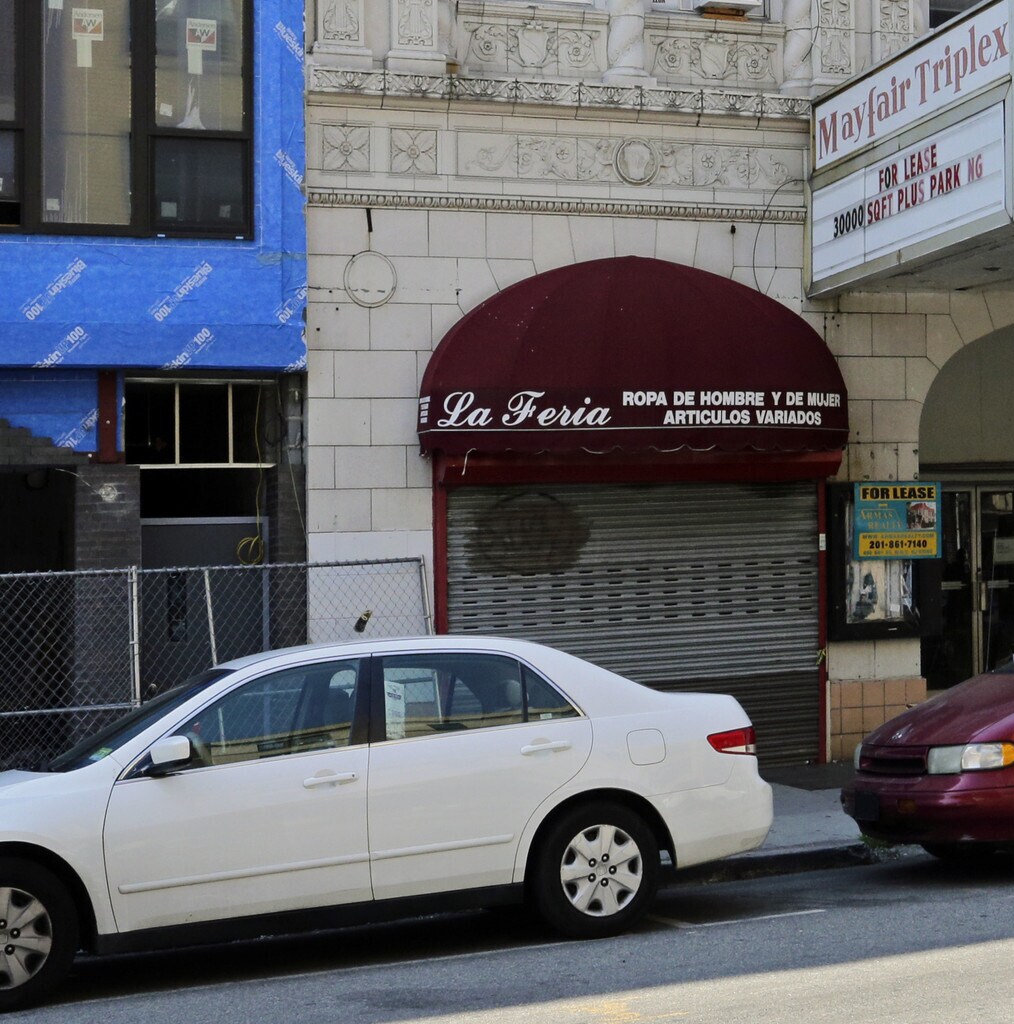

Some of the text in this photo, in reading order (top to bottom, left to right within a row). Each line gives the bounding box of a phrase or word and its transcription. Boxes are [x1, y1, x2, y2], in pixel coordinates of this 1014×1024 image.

[818, 22, 1009, 161] Mayfair Triplex
[879, 143, 938, 193] FOR LEASE
[833, 205, 864, 238] 30000
[867, 193, 893, 224] SQFT
[897, 177, 925, 212] PLUS
[437, 390, 612, 427] La Feria
[622, 391, 841, 407] ROPA DE HOMBRE Y DE MUJER
[663, 410, 822, 425] ARTICULOS VARIADOS
[862, 487, 934, 499] FOR LEASE
